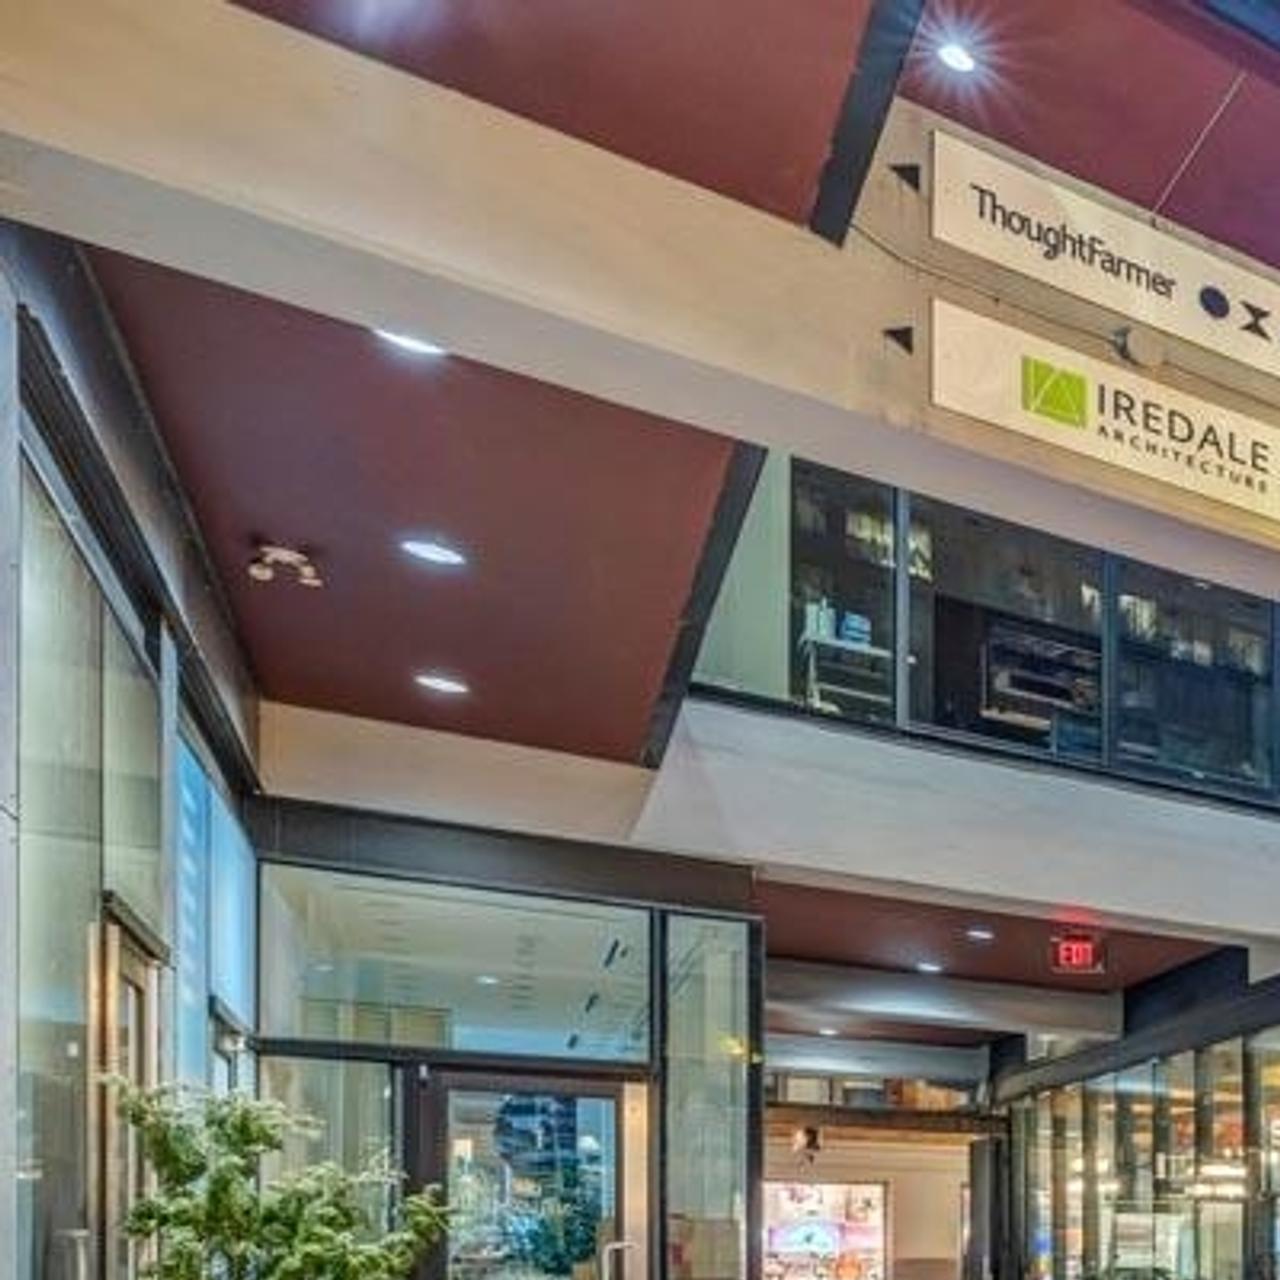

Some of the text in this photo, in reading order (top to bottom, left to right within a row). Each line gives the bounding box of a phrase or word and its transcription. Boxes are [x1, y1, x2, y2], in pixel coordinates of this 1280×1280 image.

[970, 183, 1176, 300] ThoughtFarmer
[1097, 384, 1271, 474] IREDALE
[1097, 425, 1268, 493] ARCHITECTURE
